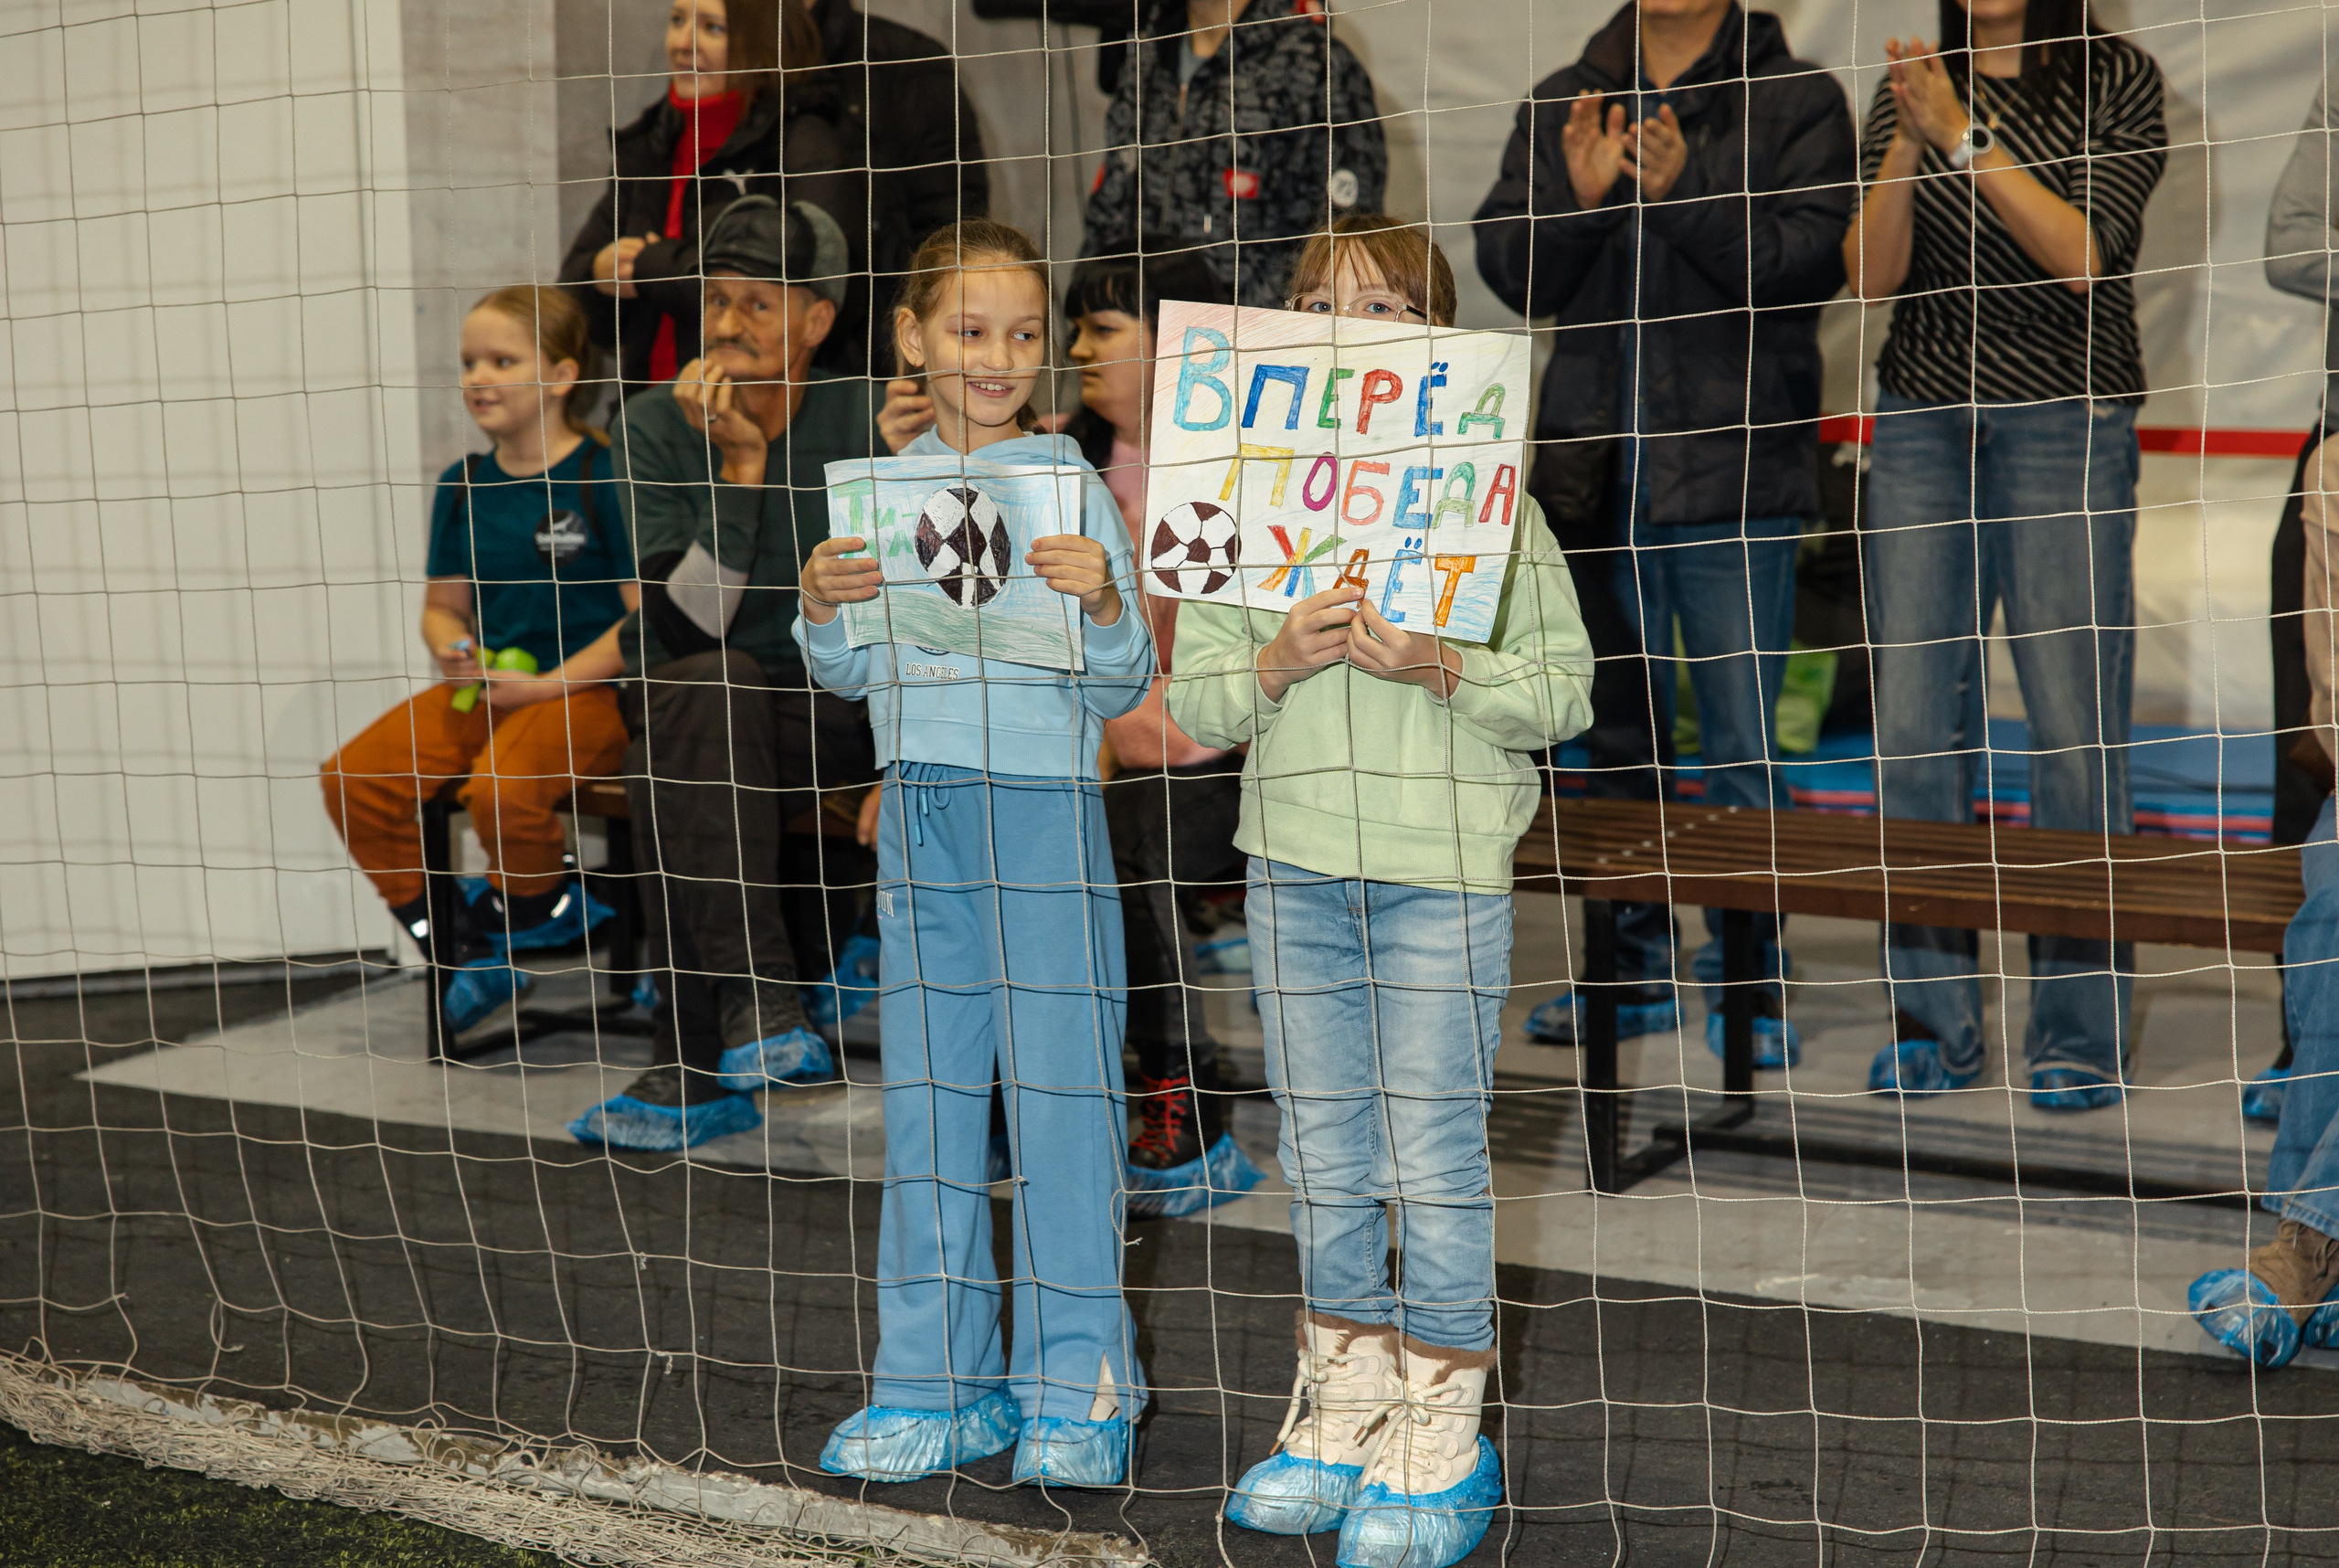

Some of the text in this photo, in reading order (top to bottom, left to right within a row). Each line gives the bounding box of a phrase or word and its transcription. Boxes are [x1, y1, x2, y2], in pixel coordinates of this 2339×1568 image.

[1173, 326, 1506, 440] ВПЕРЁД
[1218, 443, 1516, 529] ПОБЕДА
[1257, 525, 1477, 628] ЖДЁТ
[905, 662, 922, 676] LOS
